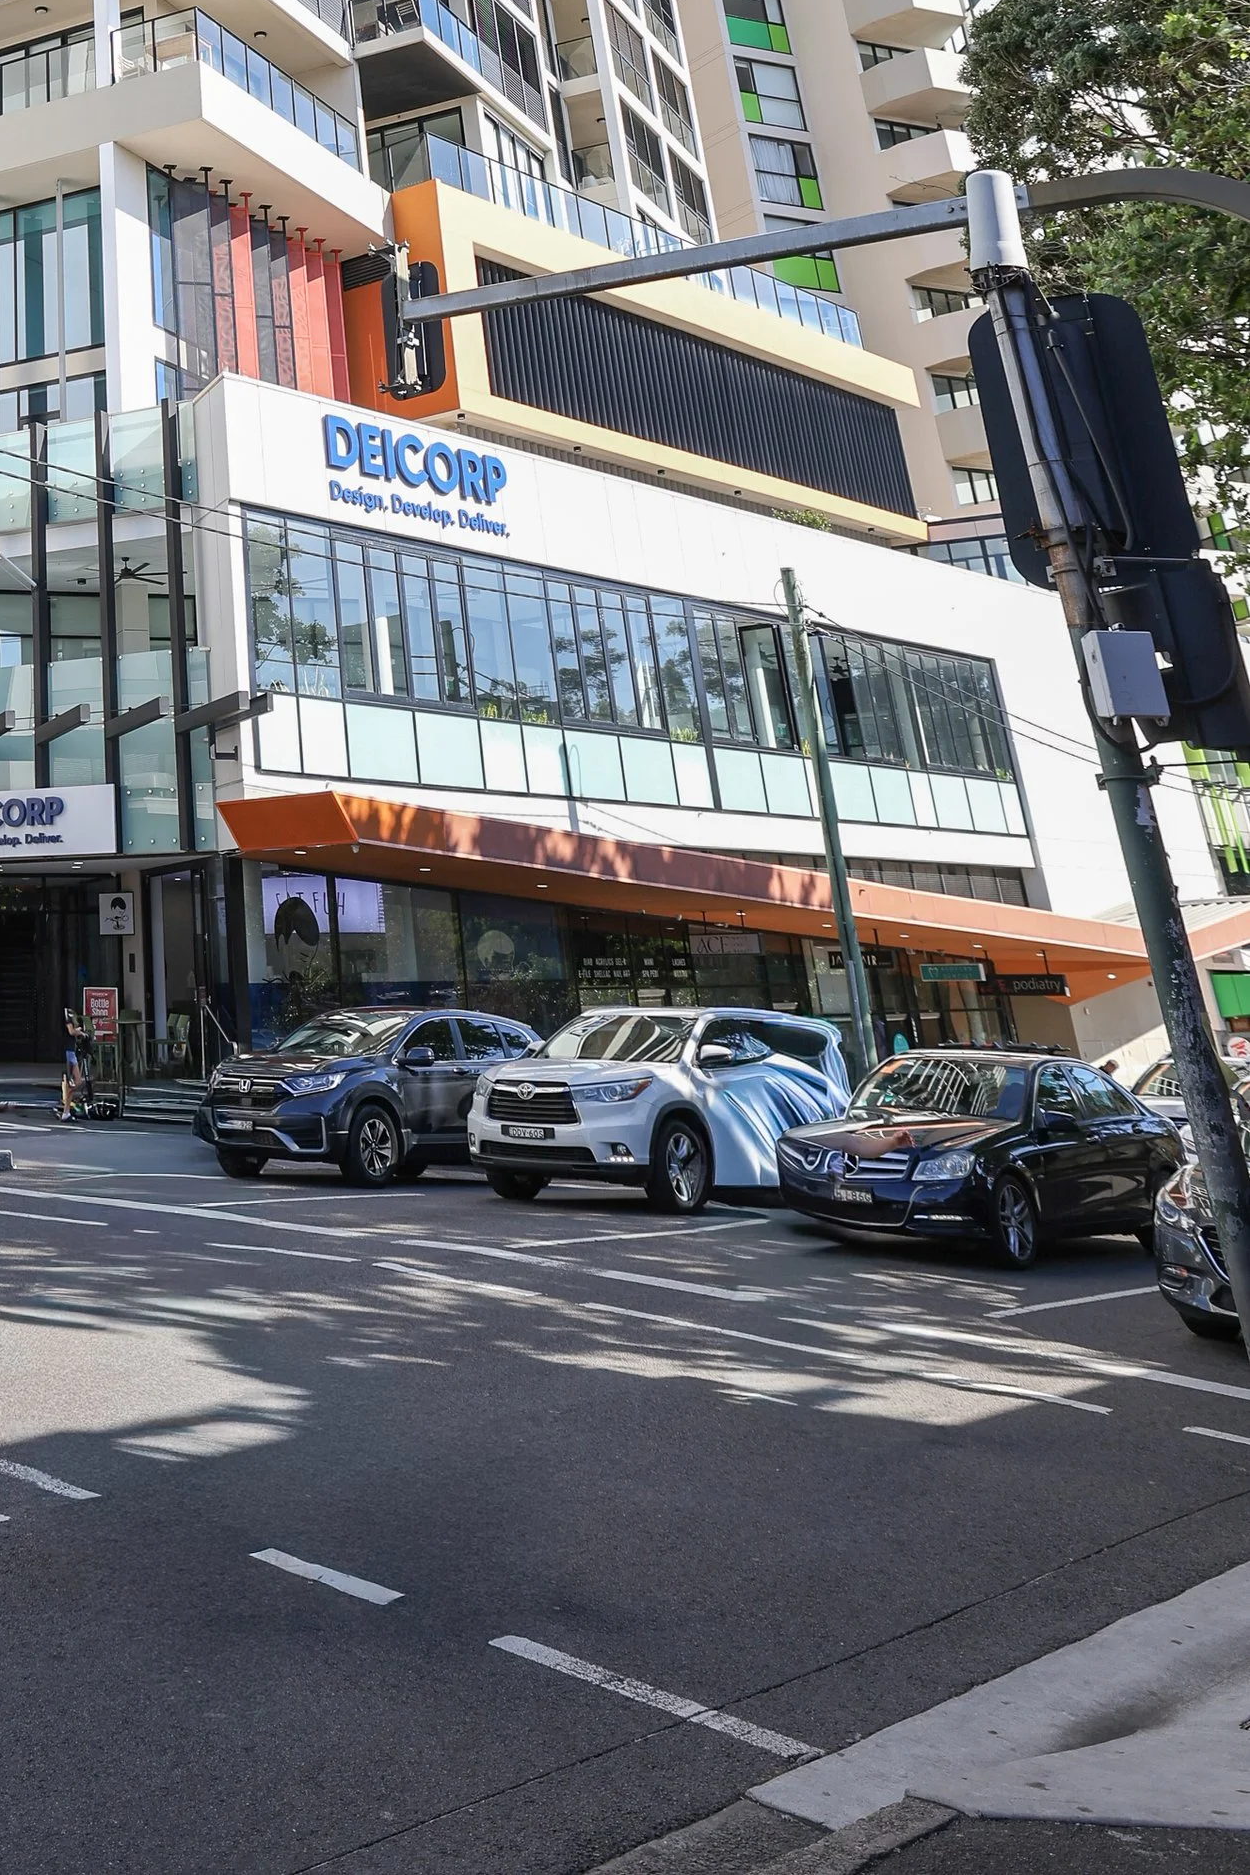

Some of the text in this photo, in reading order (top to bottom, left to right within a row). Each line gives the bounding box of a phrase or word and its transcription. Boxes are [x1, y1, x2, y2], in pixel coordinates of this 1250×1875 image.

[324, 414, 507, 505] DEICORP
[329, 480, 511, 538] Design. Develop. Deliver.
[24, 833, 64, 845] Deliver.
[1013, 977, 1061, 993] podiatry
[90, 998, 110, 1008] Bottle
